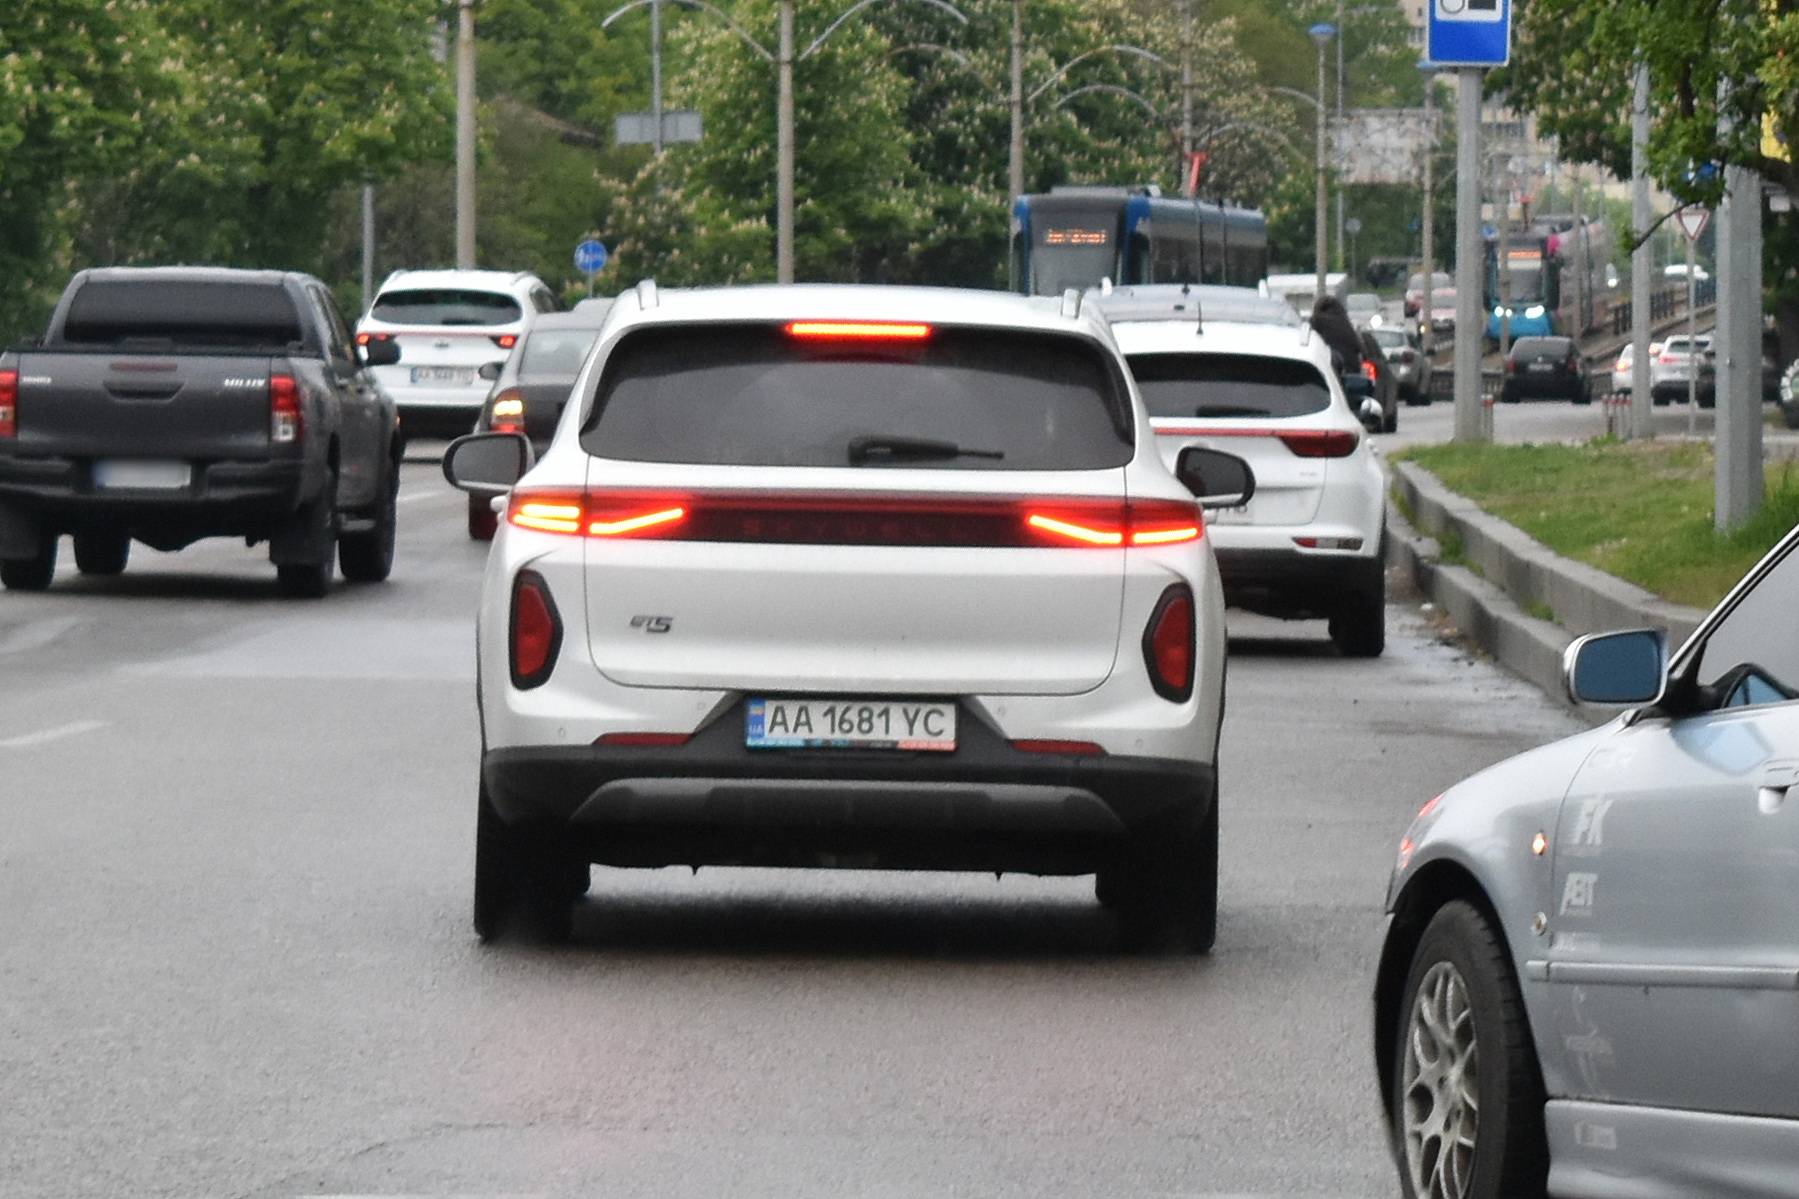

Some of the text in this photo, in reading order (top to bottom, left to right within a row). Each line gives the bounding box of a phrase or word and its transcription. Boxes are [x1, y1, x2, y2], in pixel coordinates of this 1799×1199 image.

[768, 704, 945, 736] AA 1681 YC
